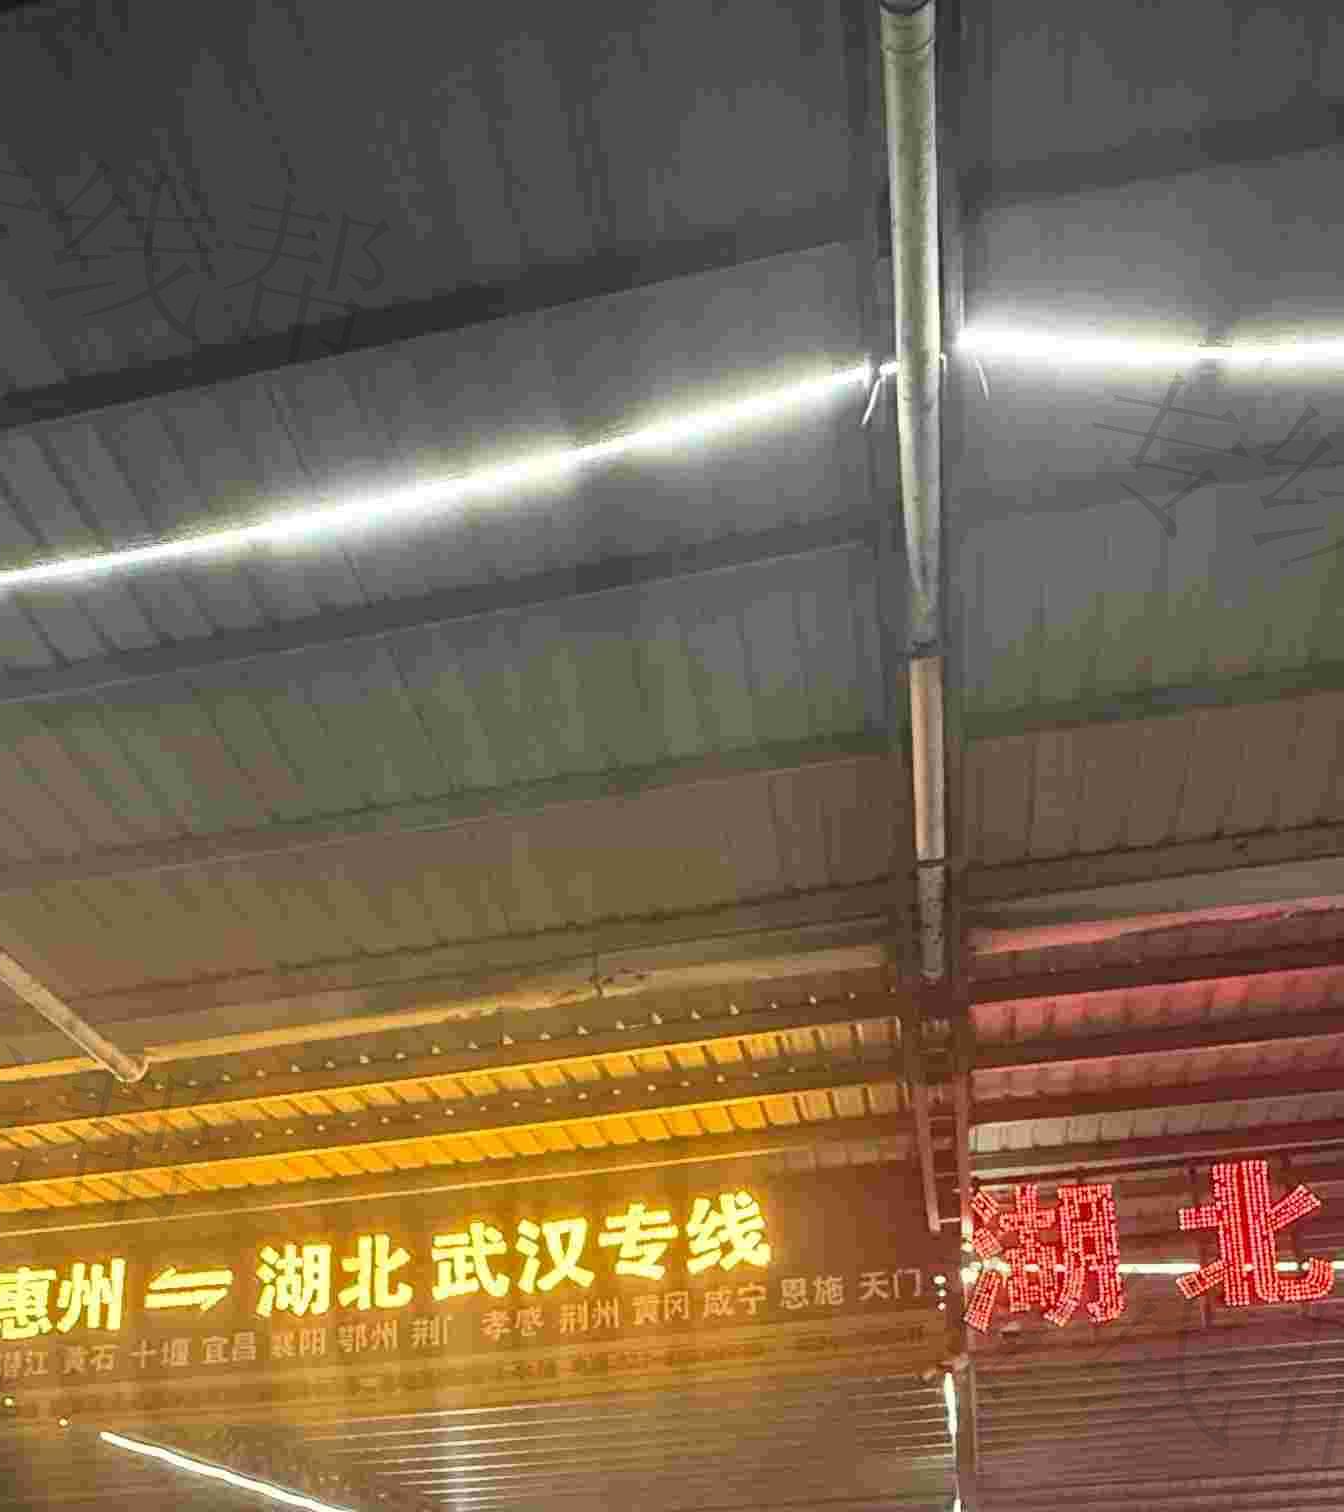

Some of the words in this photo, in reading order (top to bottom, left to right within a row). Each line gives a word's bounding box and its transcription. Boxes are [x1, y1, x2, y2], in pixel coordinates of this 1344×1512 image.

[256, 1190, 773, 1318] 湖北武汉专线
[62, 1343, 119, 1376] 黄石
[130, 1336, 191, 1369] 十堰
[200, 1331, 256, 1365] 宜昌
[337, 1318, 399, 1354] 鄂州
[481, 1303, 545, 1341] 孝感
[558, 1297, 621, 1334] 荆州
[631, 1290, 691, 1327] 黄冈
[702, 1281, 768, 1319] 咸宁
[779, 1271, 845, 1310] 恩施
[859, 1267, 922, 1302] 天门
